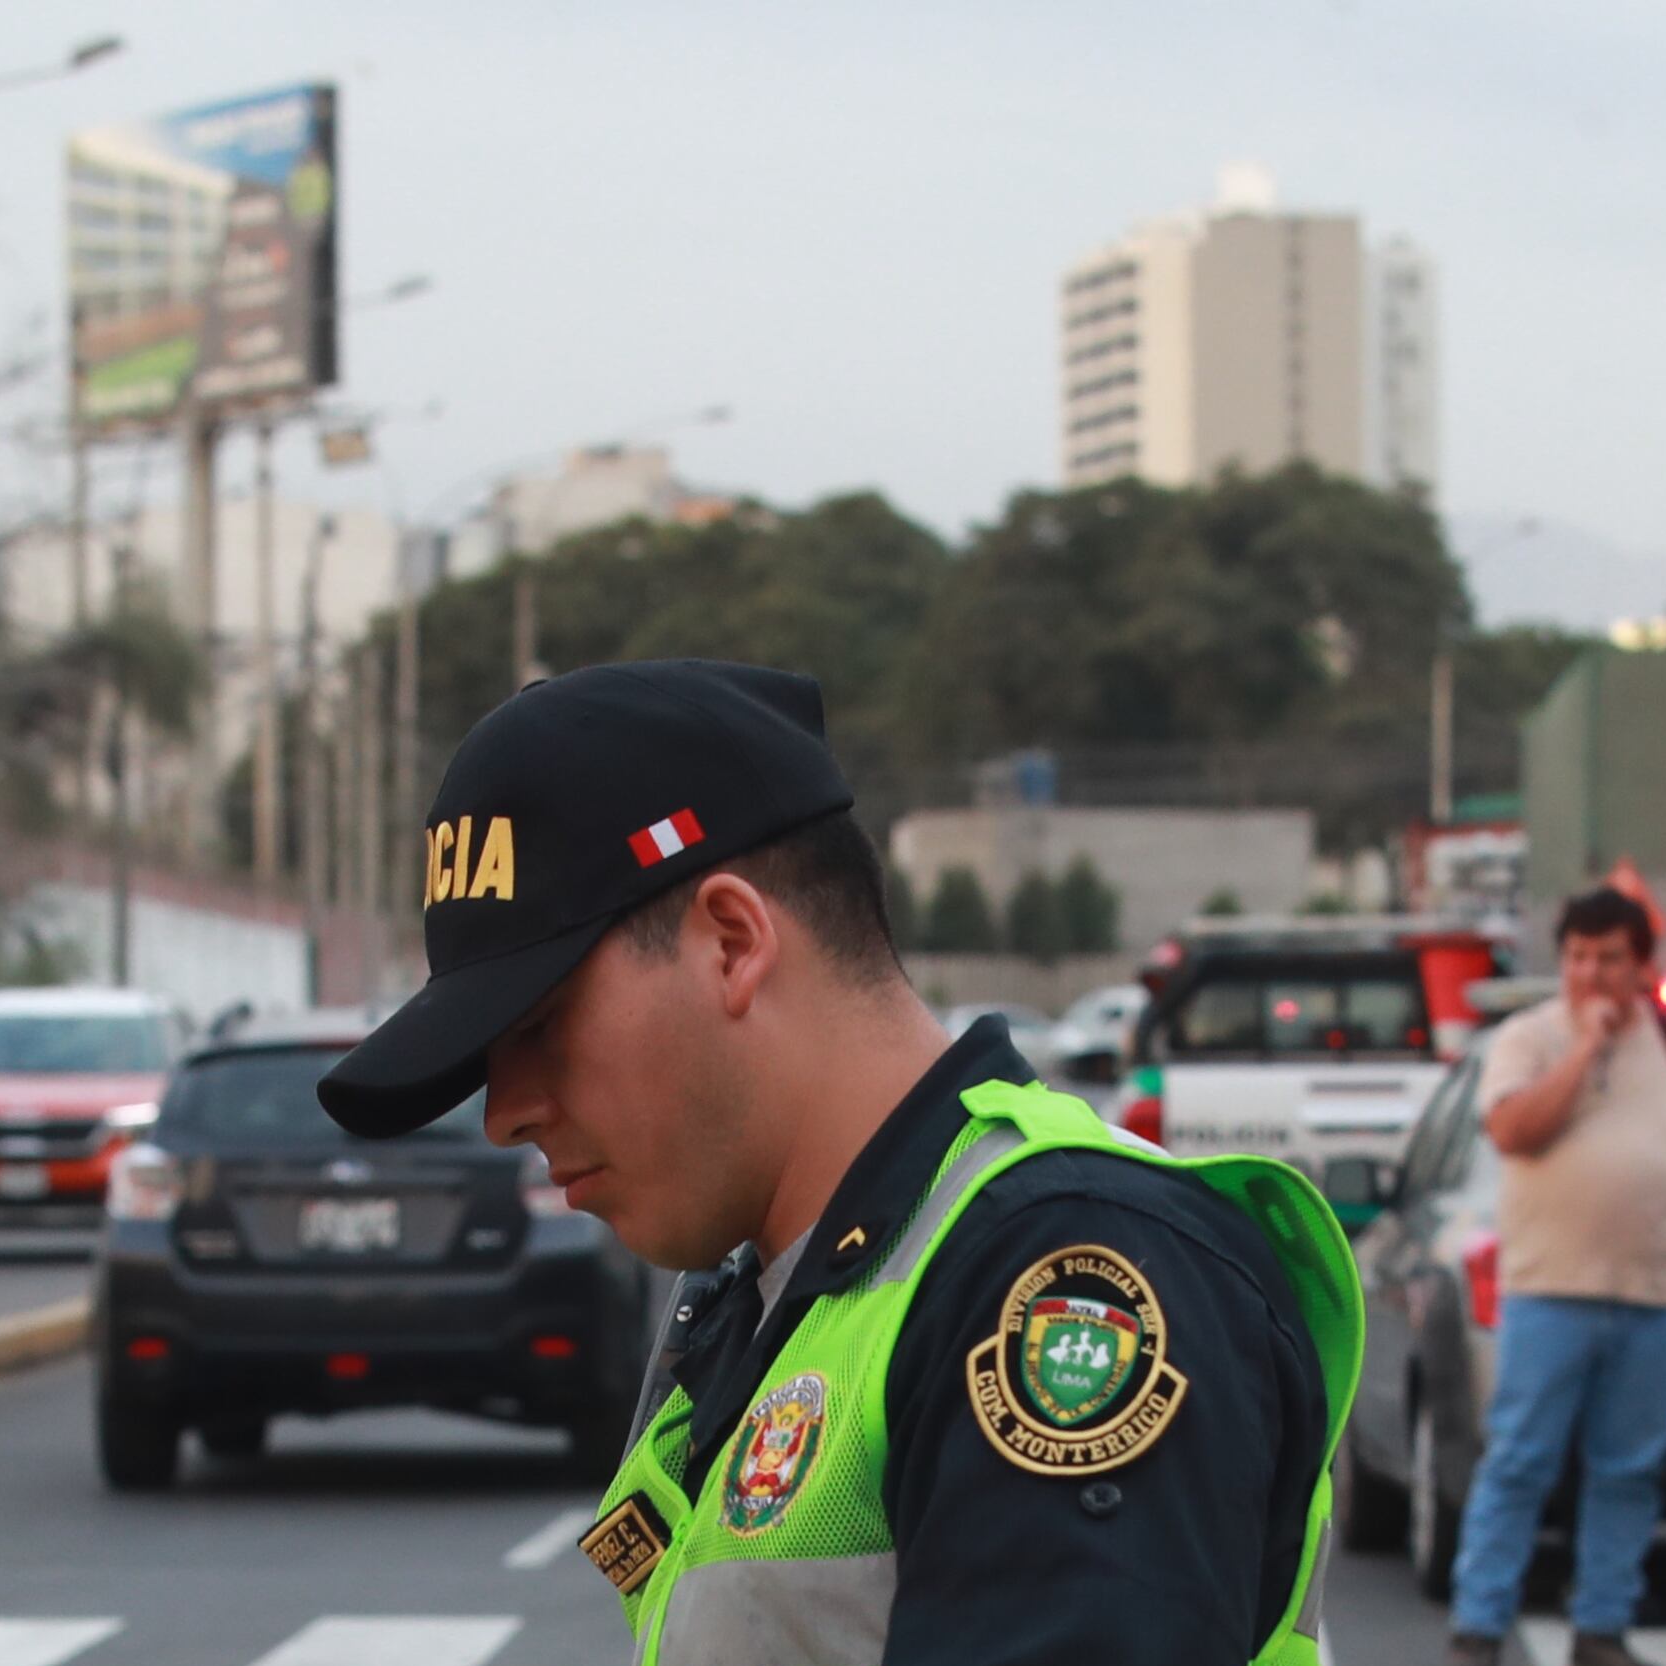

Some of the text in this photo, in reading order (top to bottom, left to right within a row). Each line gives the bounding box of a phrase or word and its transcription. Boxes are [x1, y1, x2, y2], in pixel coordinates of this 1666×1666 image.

[1008, 1266, 1057, 1333] DIVISION
[1063, 1257, 1139, 1300] POLICIAL
[976, 1370, 1009, 1429] COM.
[1006, 1392, 1169, 1464] MONTERRICO
[1052, 1371, 1093, 1390] LIMA
